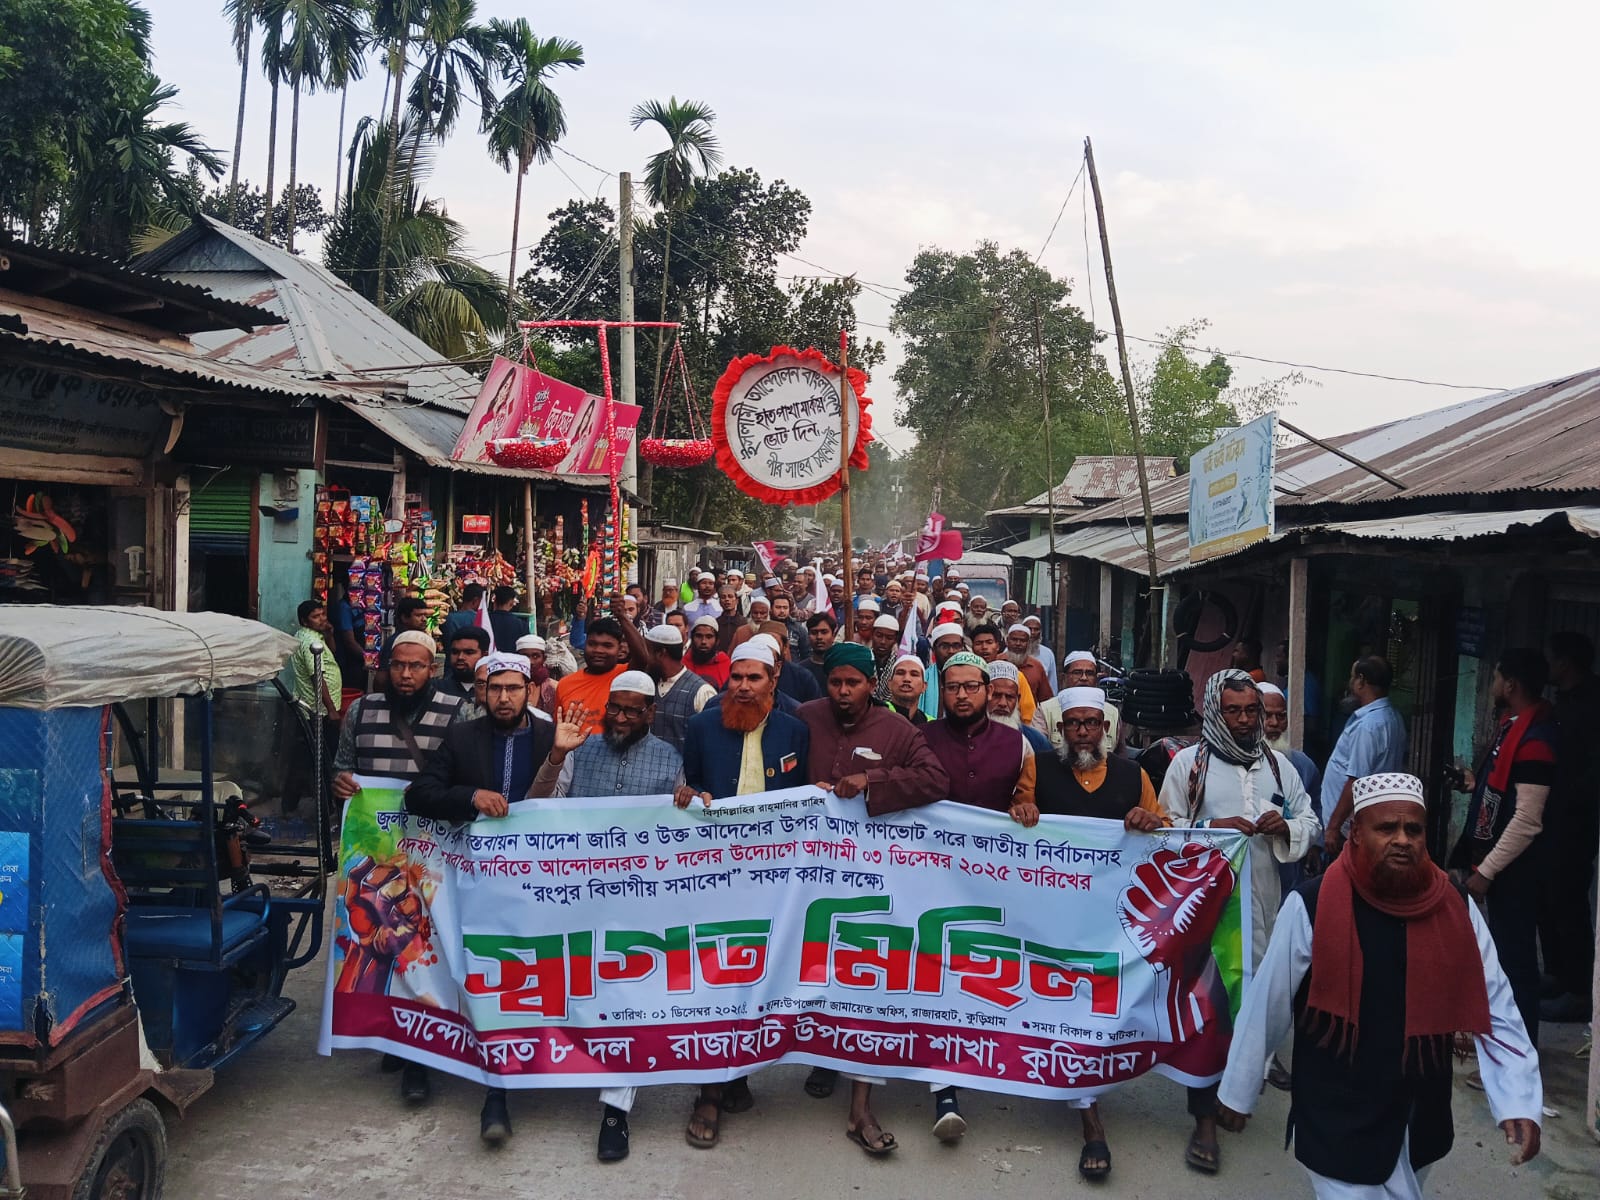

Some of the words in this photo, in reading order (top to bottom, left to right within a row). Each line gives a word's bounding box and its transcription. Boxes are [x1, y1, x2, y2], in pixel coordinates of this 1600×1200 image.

[376, 810, 409, 832] জুলই
[524, 831, 580, 852] আদেশ
[585, 826, 627, 849] জারি
[633, 832, 650, 846] ও
[653, 822, 690, 844] উক্ত
[696, 822, 774, 842] আদেশের
[778, 814, 820, 838] উপর
[825, 815, 860, 838] আগে
[864, 820, 929, 843] গণভোট
[932, 829, 967, 849] পরে
[972, 834, 1027, 859] জাতীয়
[1033, 838, 1123, 868] নির্বাচনসহ
[479, 854, 531, 877] দাবিতে
[537, 854, 648, 877] আন্দোলনরত
[654, 857, 668, 871] ৮
[675, 849, 724, 868] দলের
[729, 839, 798, 865] উদ্যোগে
[801, 836, 859, 862] আগামী
[888, 843, 953, 869] ডিসেম্বর
[958, 856, 1012, 883] ২০২৫
[1016, 864, 1093, 893] তারিখের
[521, 883, 581, 906] “রংপুর
[587, 876, 656, 903] বিভাগীয়
[663, 867, 743, 895] সমাবেশ”
[749, 865, 792, 885] সফল
[794, 864, 837, 886] করার
[463, 917, 773, 1020] স্বাগত
[799, 894, 1123, 1018] মিছিল
[671, 1004, 712, 1018] ডিসেম্বর
[830, 1001, 875, 1015] জামায়েত
[876, 1006, 909, 1020] অফিস,
[911, 1008, 963, 1024] রাজারহাট,
[966, 1011, 1008, 1027] কুড়িগ্রাম
[1031, 1019, 1057, 1034] সময়
[1059, 1020, 1093, 1040] বিকাল
[1095, 1031, 1105, 1039] ৪
[549, 1038, 574, 1063] ৮
[583, 1036, 634, 1064] দল
[794, 1016, 918, 1060] উপজেলা
[928, 1034, 1007, 1076] শাখা,
[1019, 1045, 1143, 1085] কুড়িগ্রাম
